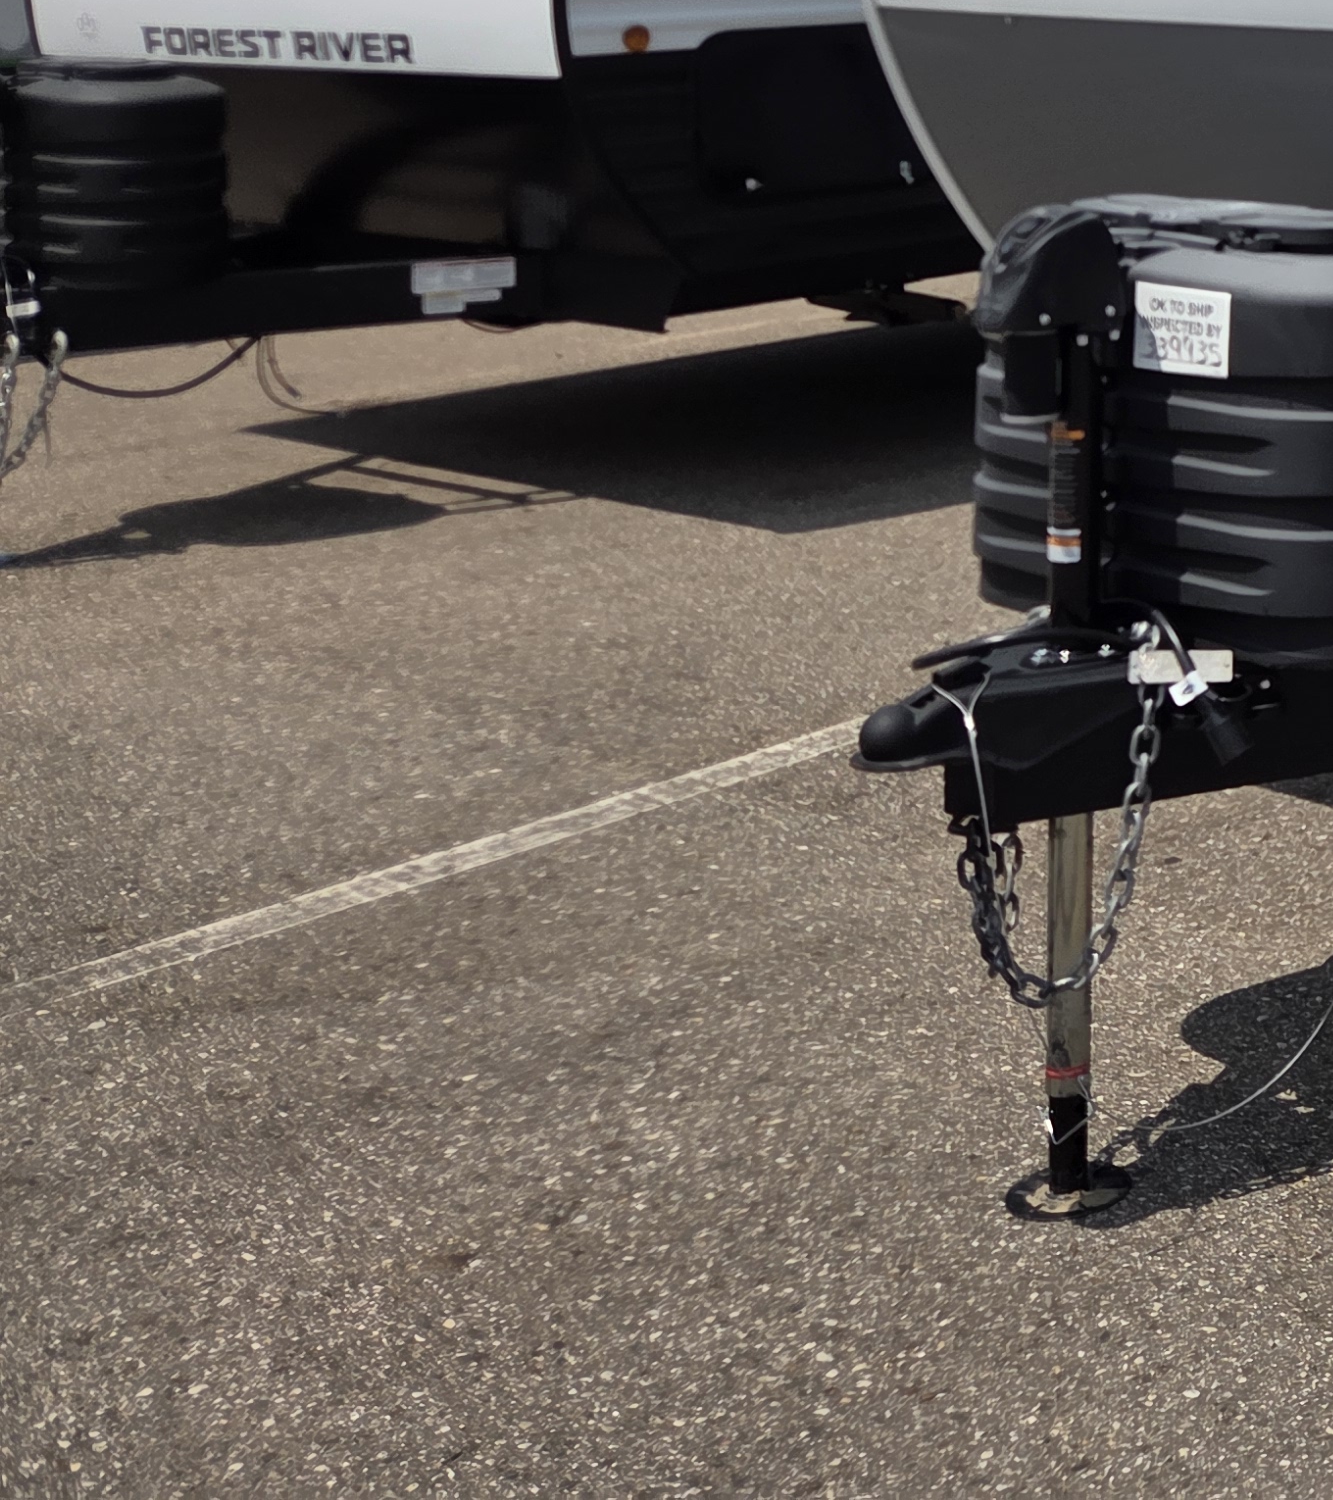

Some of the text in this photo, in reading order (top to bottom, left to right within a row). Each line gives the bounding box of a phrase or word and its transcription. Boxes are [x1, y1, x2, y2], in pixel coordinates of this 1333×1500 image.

[140, 26, 416, 64] FOREST RIVER
[1169, 299, 1185, 315] TO
